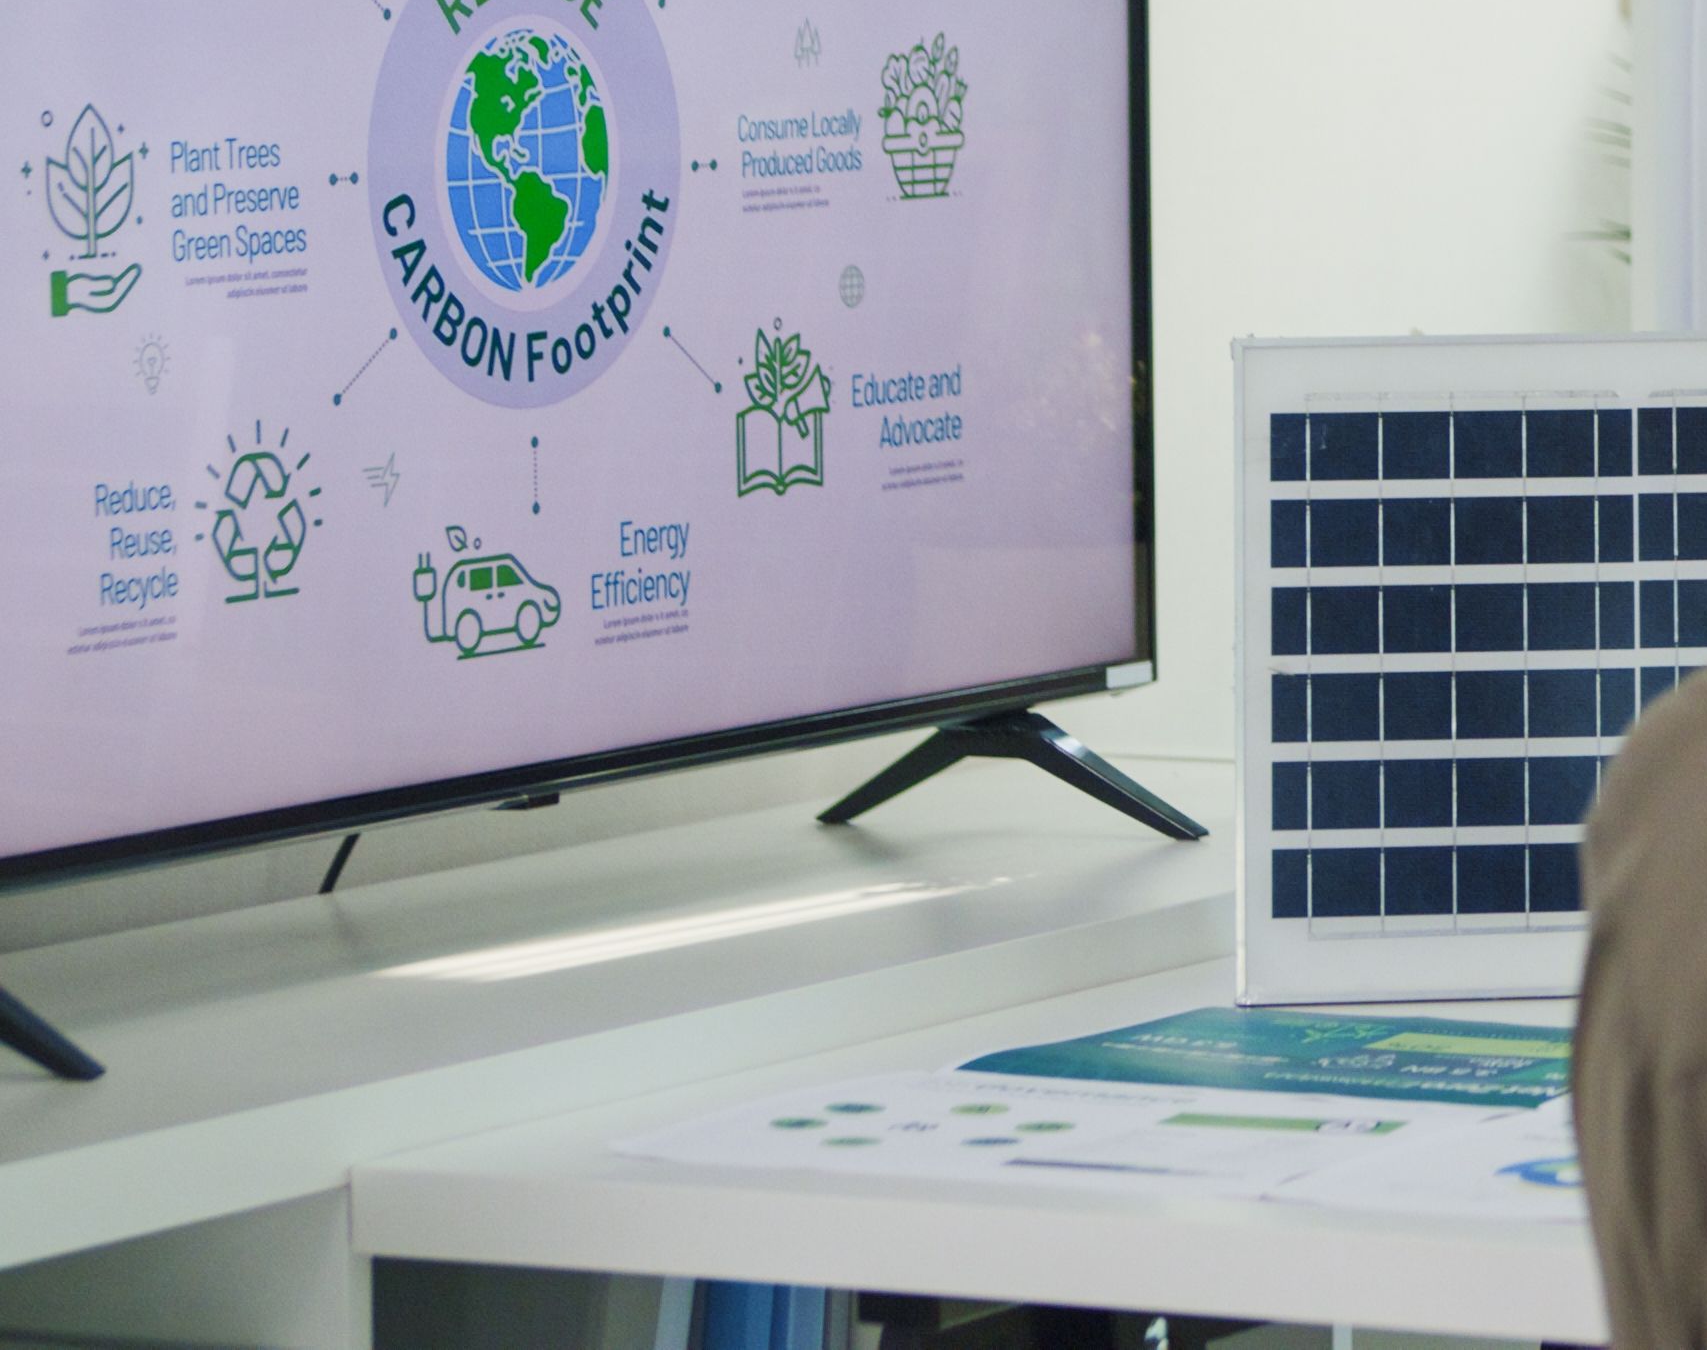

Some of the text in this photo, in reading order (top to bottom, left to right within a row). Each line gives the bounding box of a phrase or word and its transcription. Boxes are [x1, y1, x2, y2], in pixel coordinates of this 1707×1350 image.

[737, 109, 862, 144] Consume Locally
[170, 138, 281, 174] Plant Trees
[741, 145, 863, 178] Produced Goods
[171, 181, 300, 218] and Preserve
[172, 225, 307, 264] Green Spaces
[383, 189, 669, 382] CARBON Footprint
[852, 365, 962, 408] Educate and
[880, 411, 963, 449] Advocate
[95, 480, 176, 517] Reduce,
[110, 526, 177, 560] Reuse,
[620, 519, 690, 558] Energy
[100, 568, 178, 610] Recycle
[591, 567, 691, 610] Efficiency
